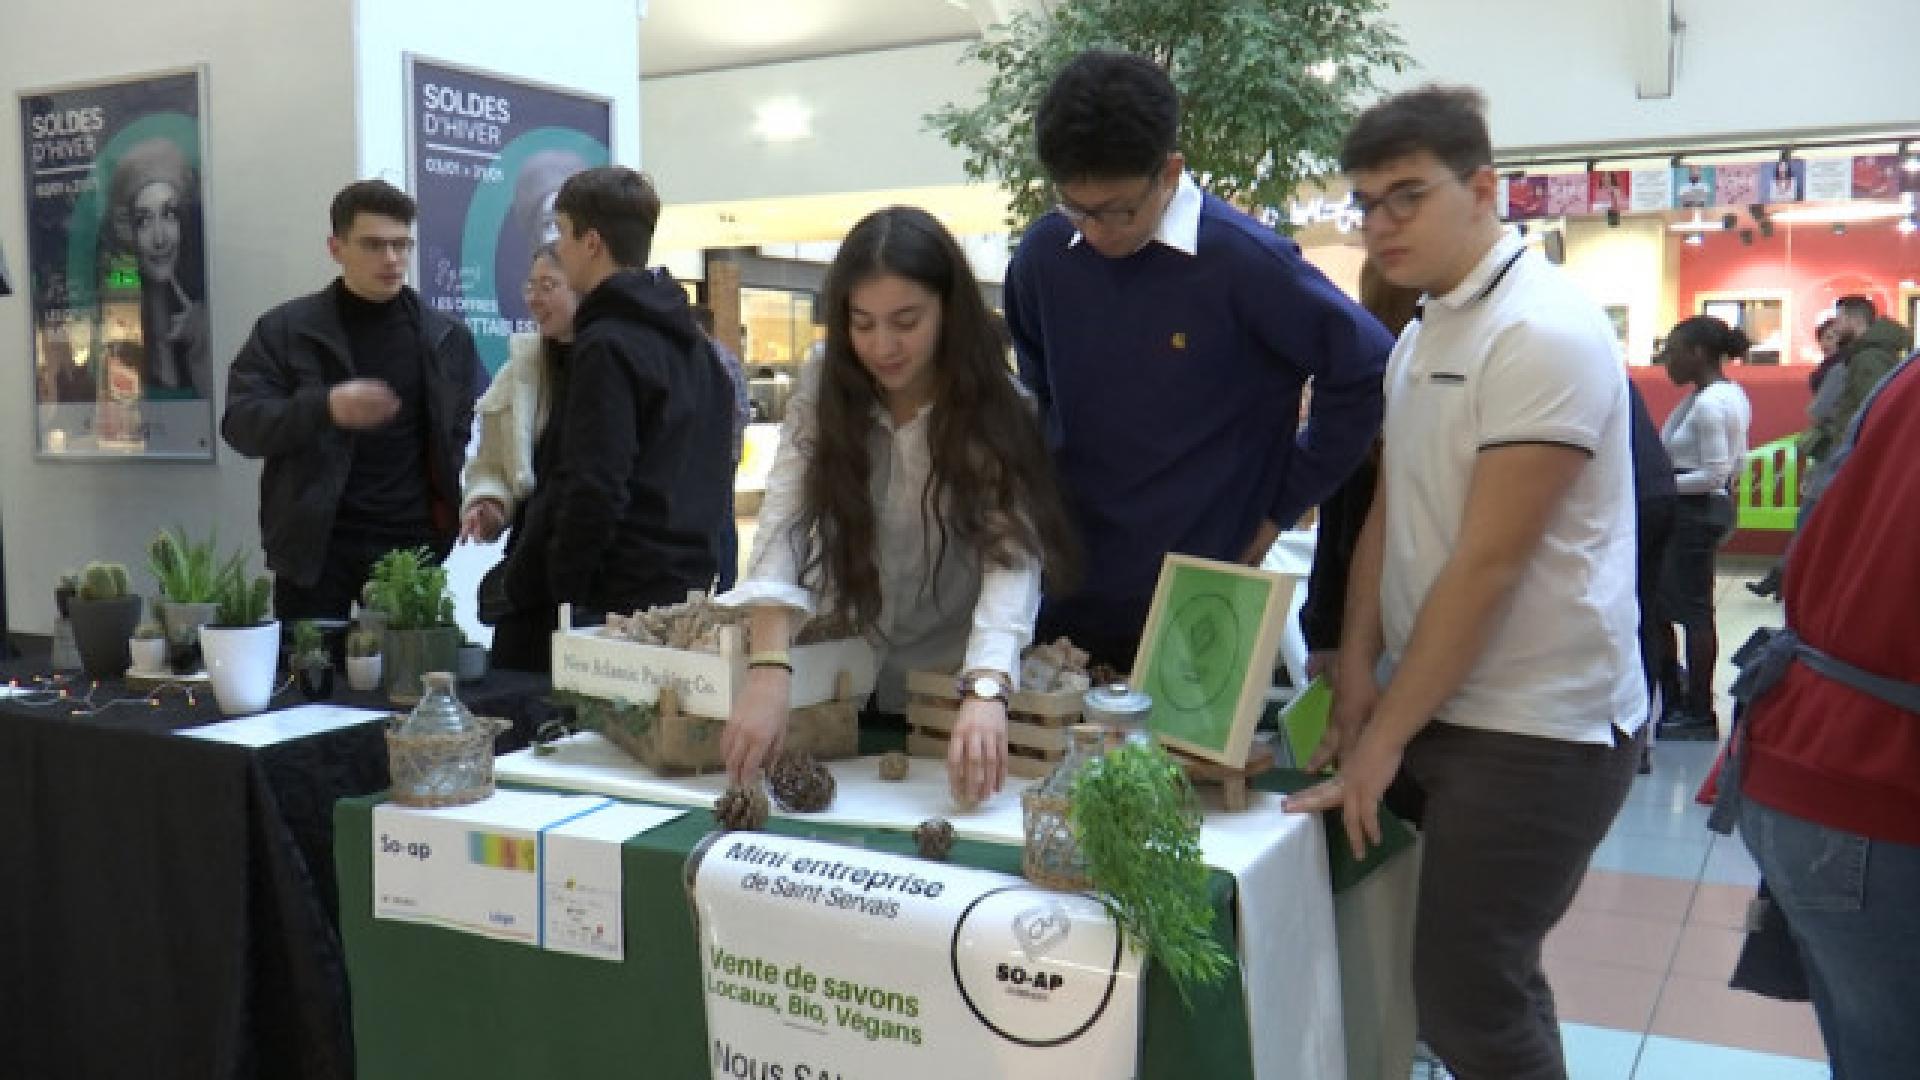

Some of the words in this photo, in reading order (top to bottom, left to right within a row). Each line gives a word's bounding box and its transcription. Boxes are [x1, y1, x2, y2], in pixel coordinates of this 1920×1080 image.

[423, 83, 510, 123] SOLDES
[32, 106, 103, 138] SOLDES
[424, 113, 502, 145] D'HIVER
[741, 872, 769, 892] de
[707, 972, 781, 1014] Locaux,
[788, 993, 828, 1026] Bio,
[711, 945, 779, 984] Vente
[784, 963, 818, 993] de
[823, 977, 919, 1017] savons
